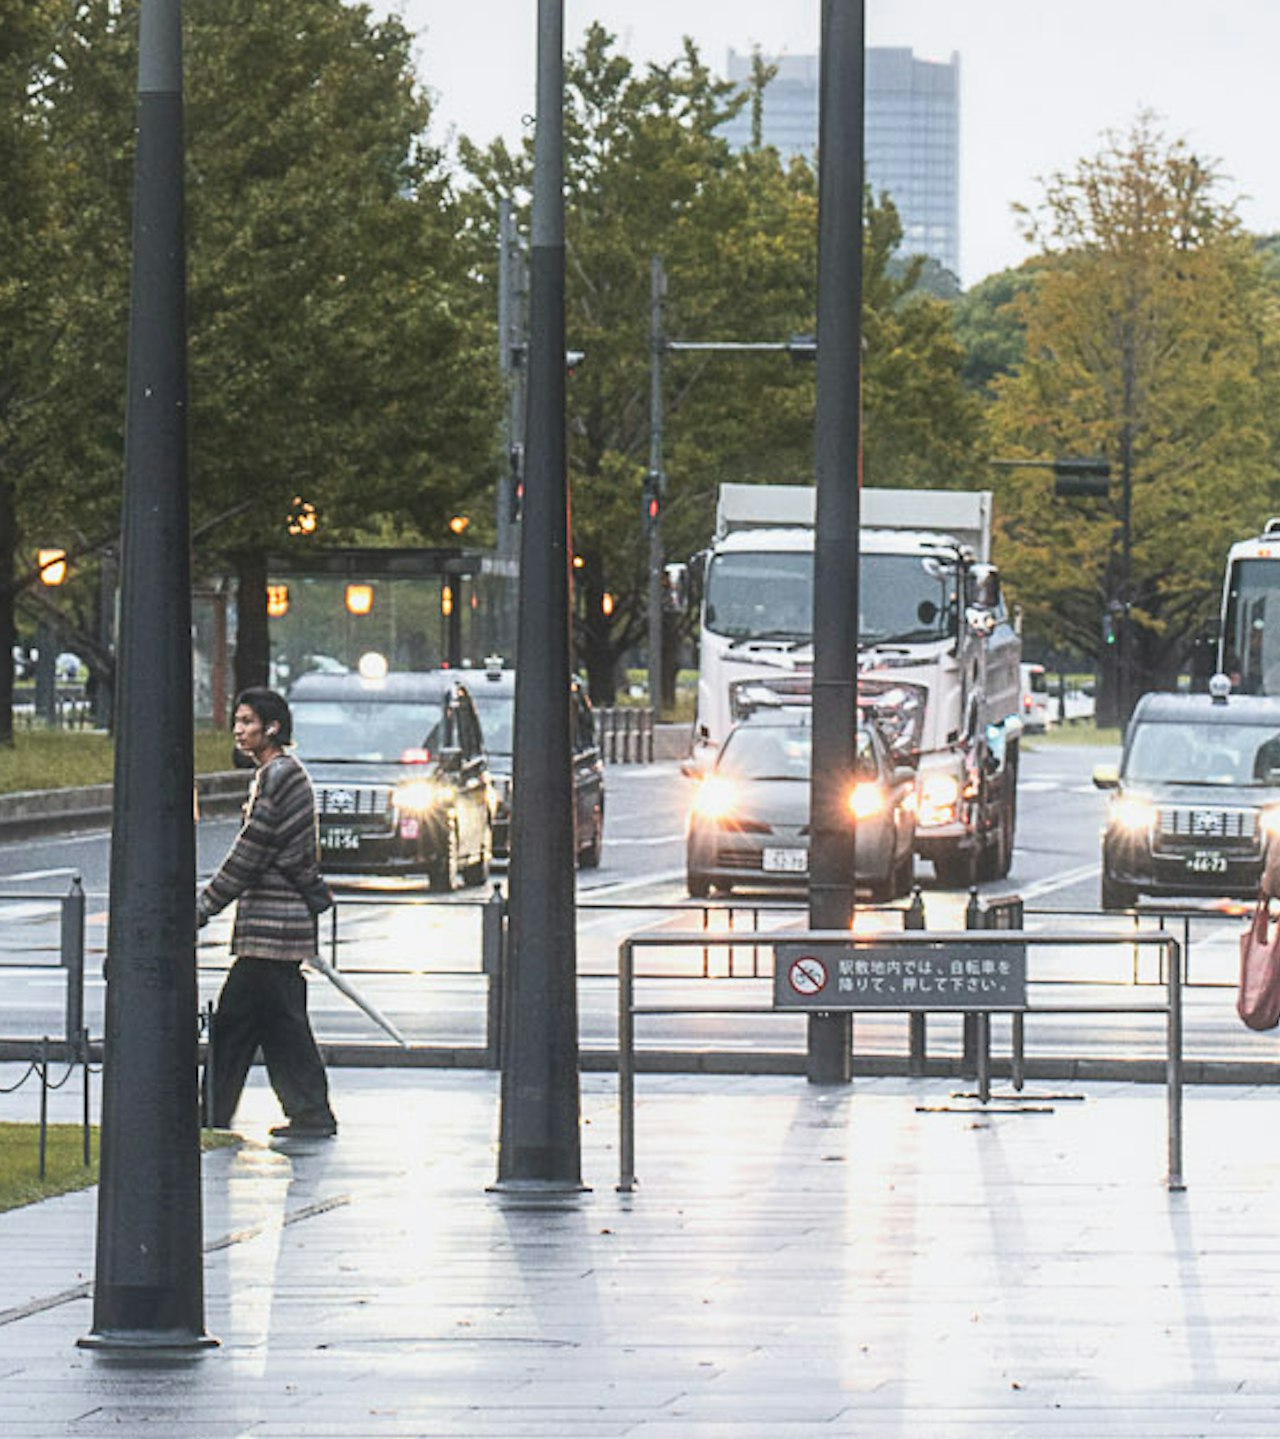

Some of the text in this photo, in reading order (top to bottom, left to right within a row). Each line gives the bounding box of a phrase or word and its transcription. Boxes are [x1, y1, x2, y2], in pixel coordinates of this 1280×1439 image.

[838, 977, 1007, 992] 降りて、押して下さい。
